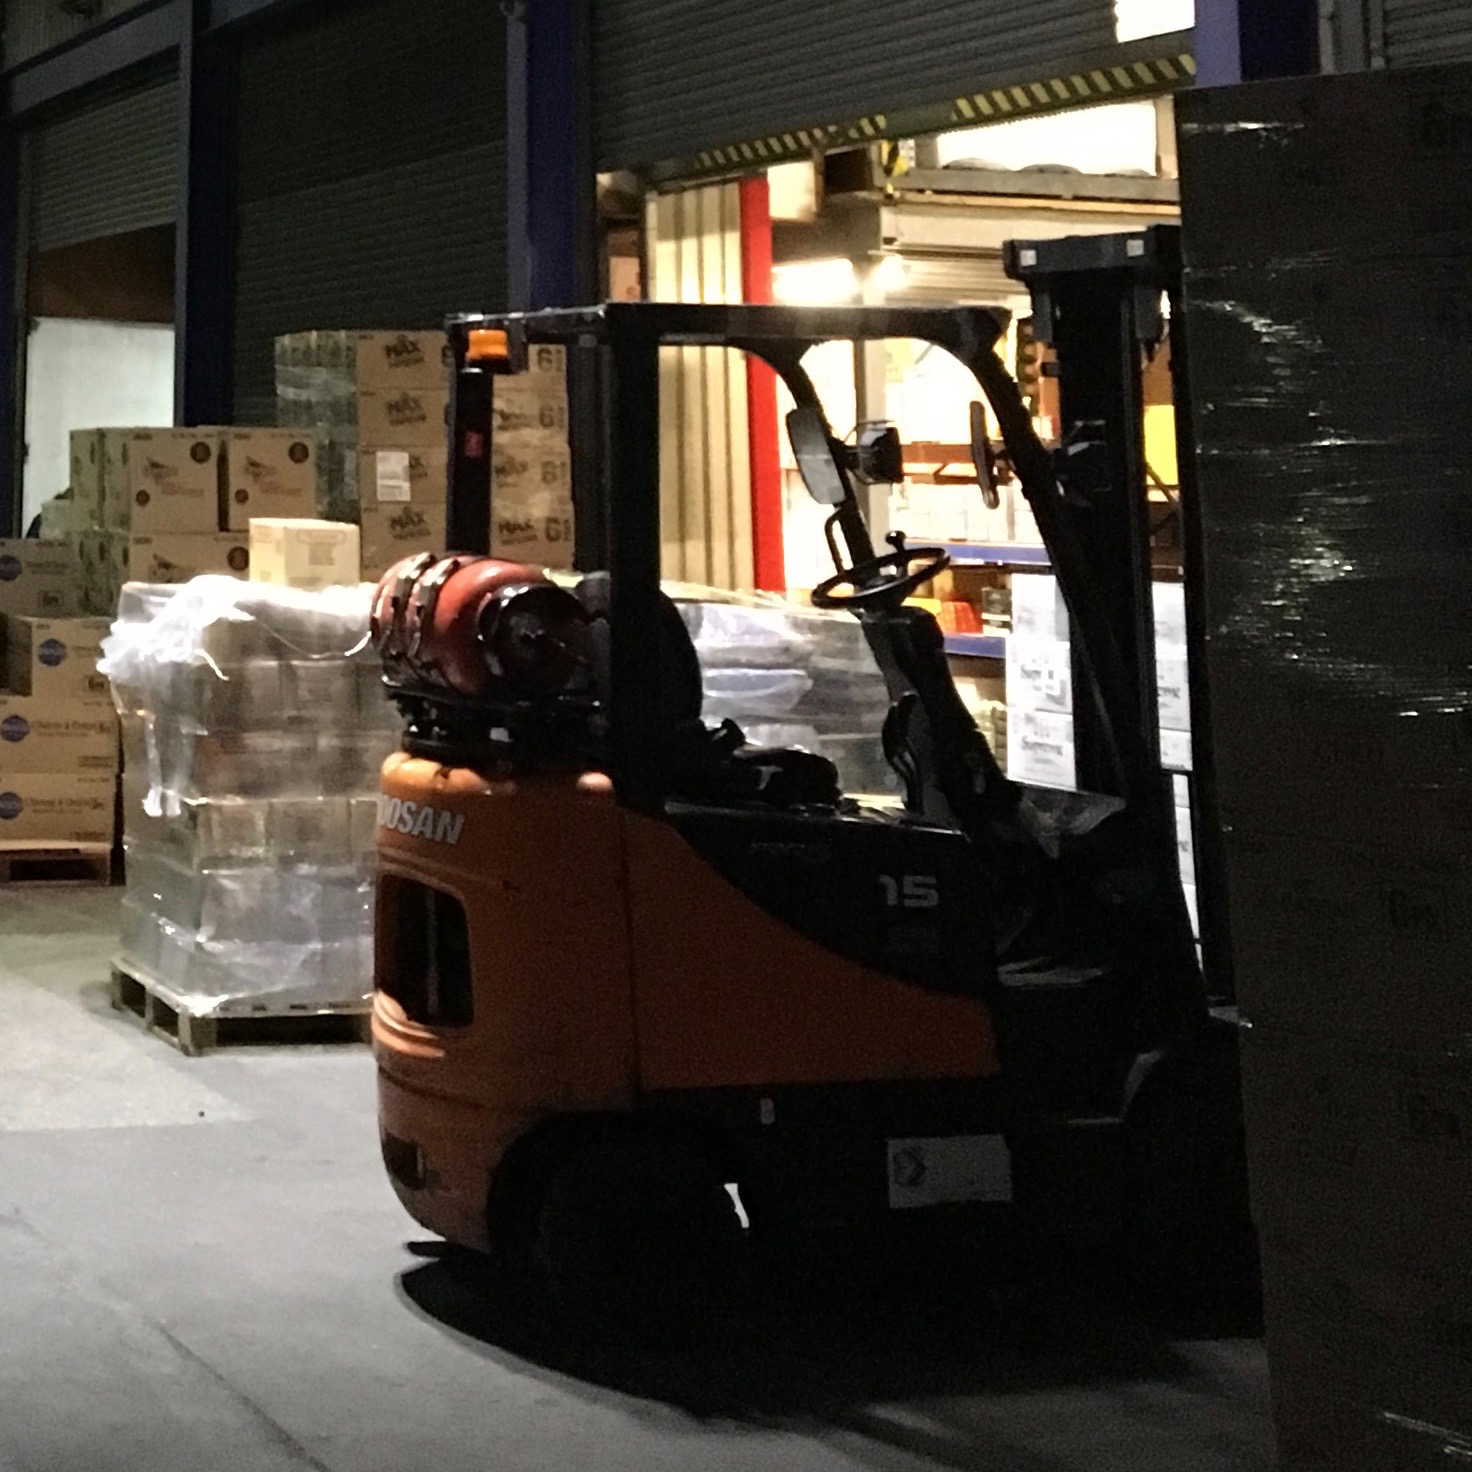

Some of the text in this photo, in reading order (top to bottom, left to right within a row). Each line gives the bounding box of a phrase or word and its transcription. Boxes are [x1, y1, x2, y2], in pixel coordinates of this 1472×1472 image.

[537, 347, 553, 372] 6
[545, 517, 562, 543] 6
[878, 873, 940, 908] 15
